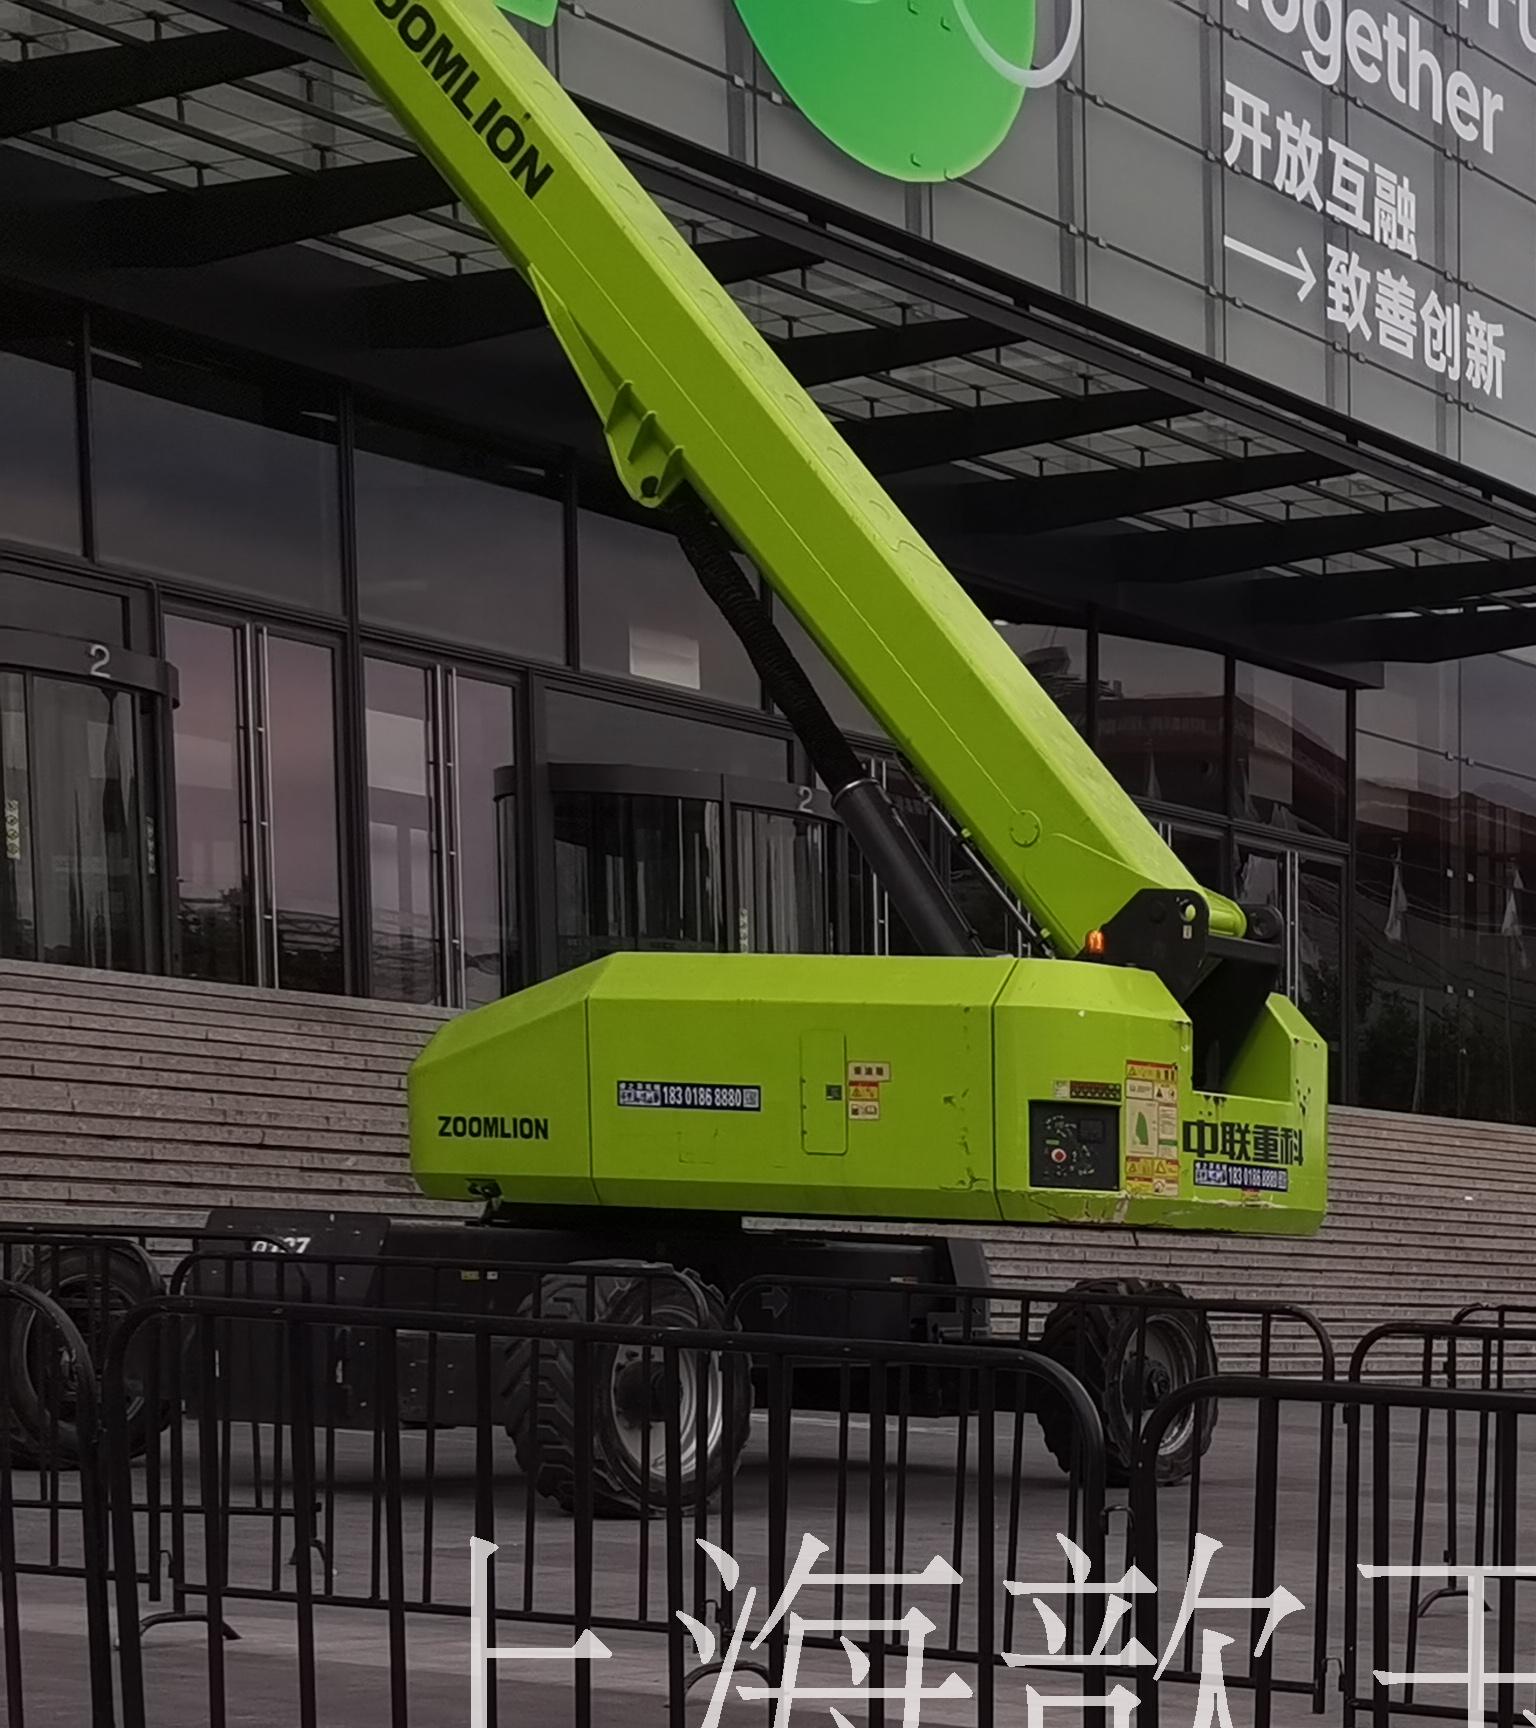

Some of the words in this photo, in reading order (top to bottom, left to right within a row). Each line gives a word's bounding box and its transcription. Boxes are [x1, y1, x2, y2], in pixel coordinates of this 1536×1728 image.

[1223, 80, 1418, 261] 开放互融
[1326, 244, 1505, 400] 致善创新
[89, 644, 111, 678] 2
[438, 1116, 549, 1140] ZOOMLION
[1182, 1119, 1304, 1166] 中联重科
